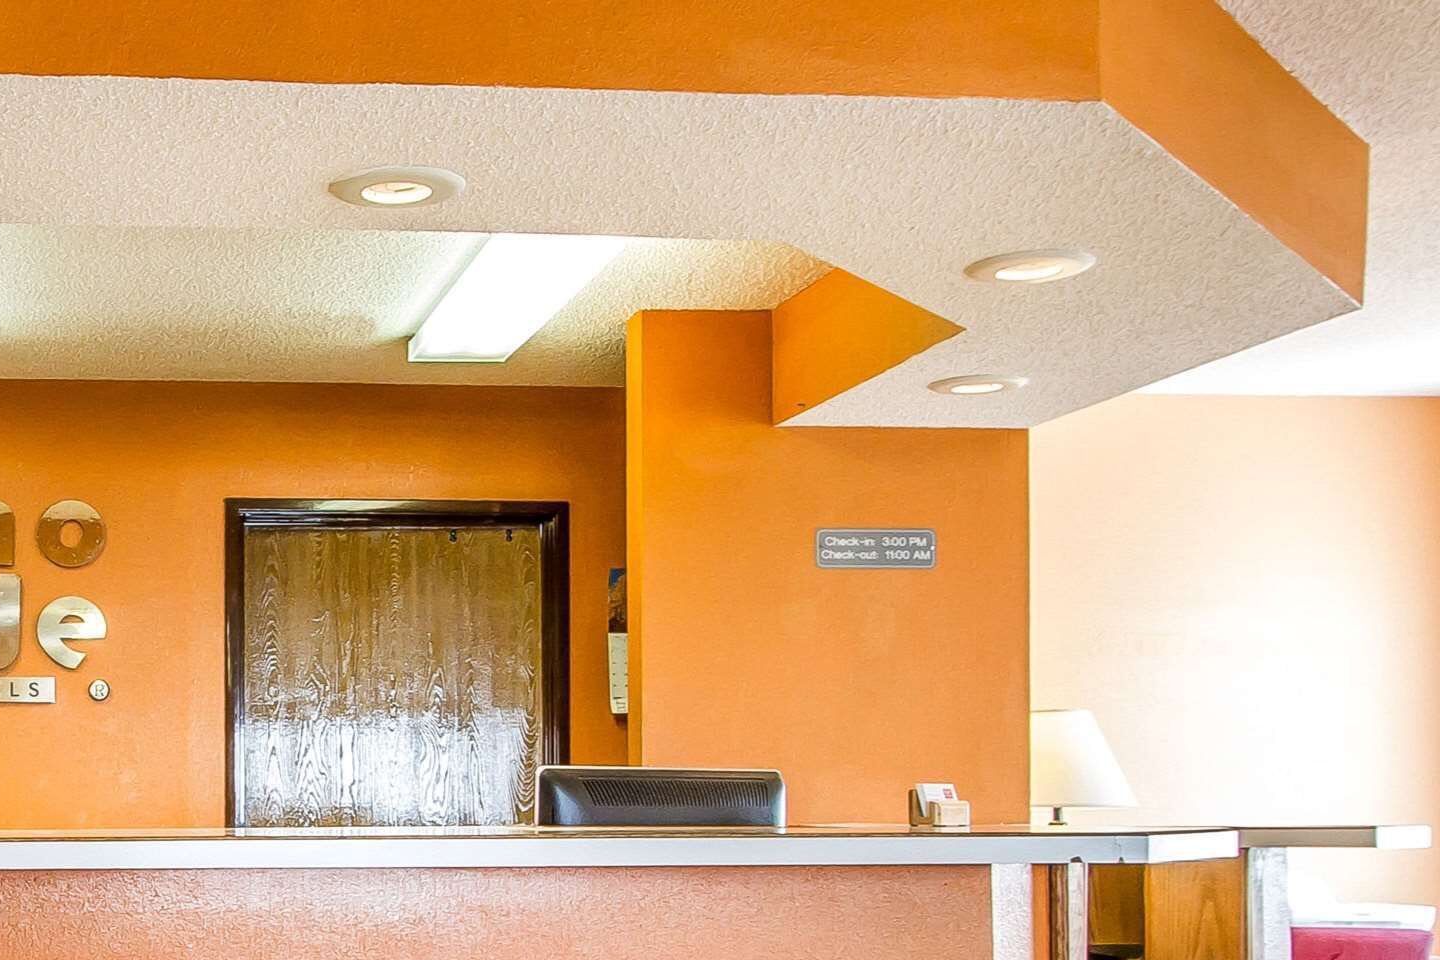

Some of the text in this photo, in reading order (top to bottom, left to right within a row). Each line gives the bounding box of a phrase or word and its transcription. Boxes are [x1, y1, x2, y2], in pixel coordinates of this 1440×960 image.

[824, 536, 927, 547] Check-in: 3:00 PM
[885, 550, 910, 560] 11:00
[913, 550, 931, 560] AM
